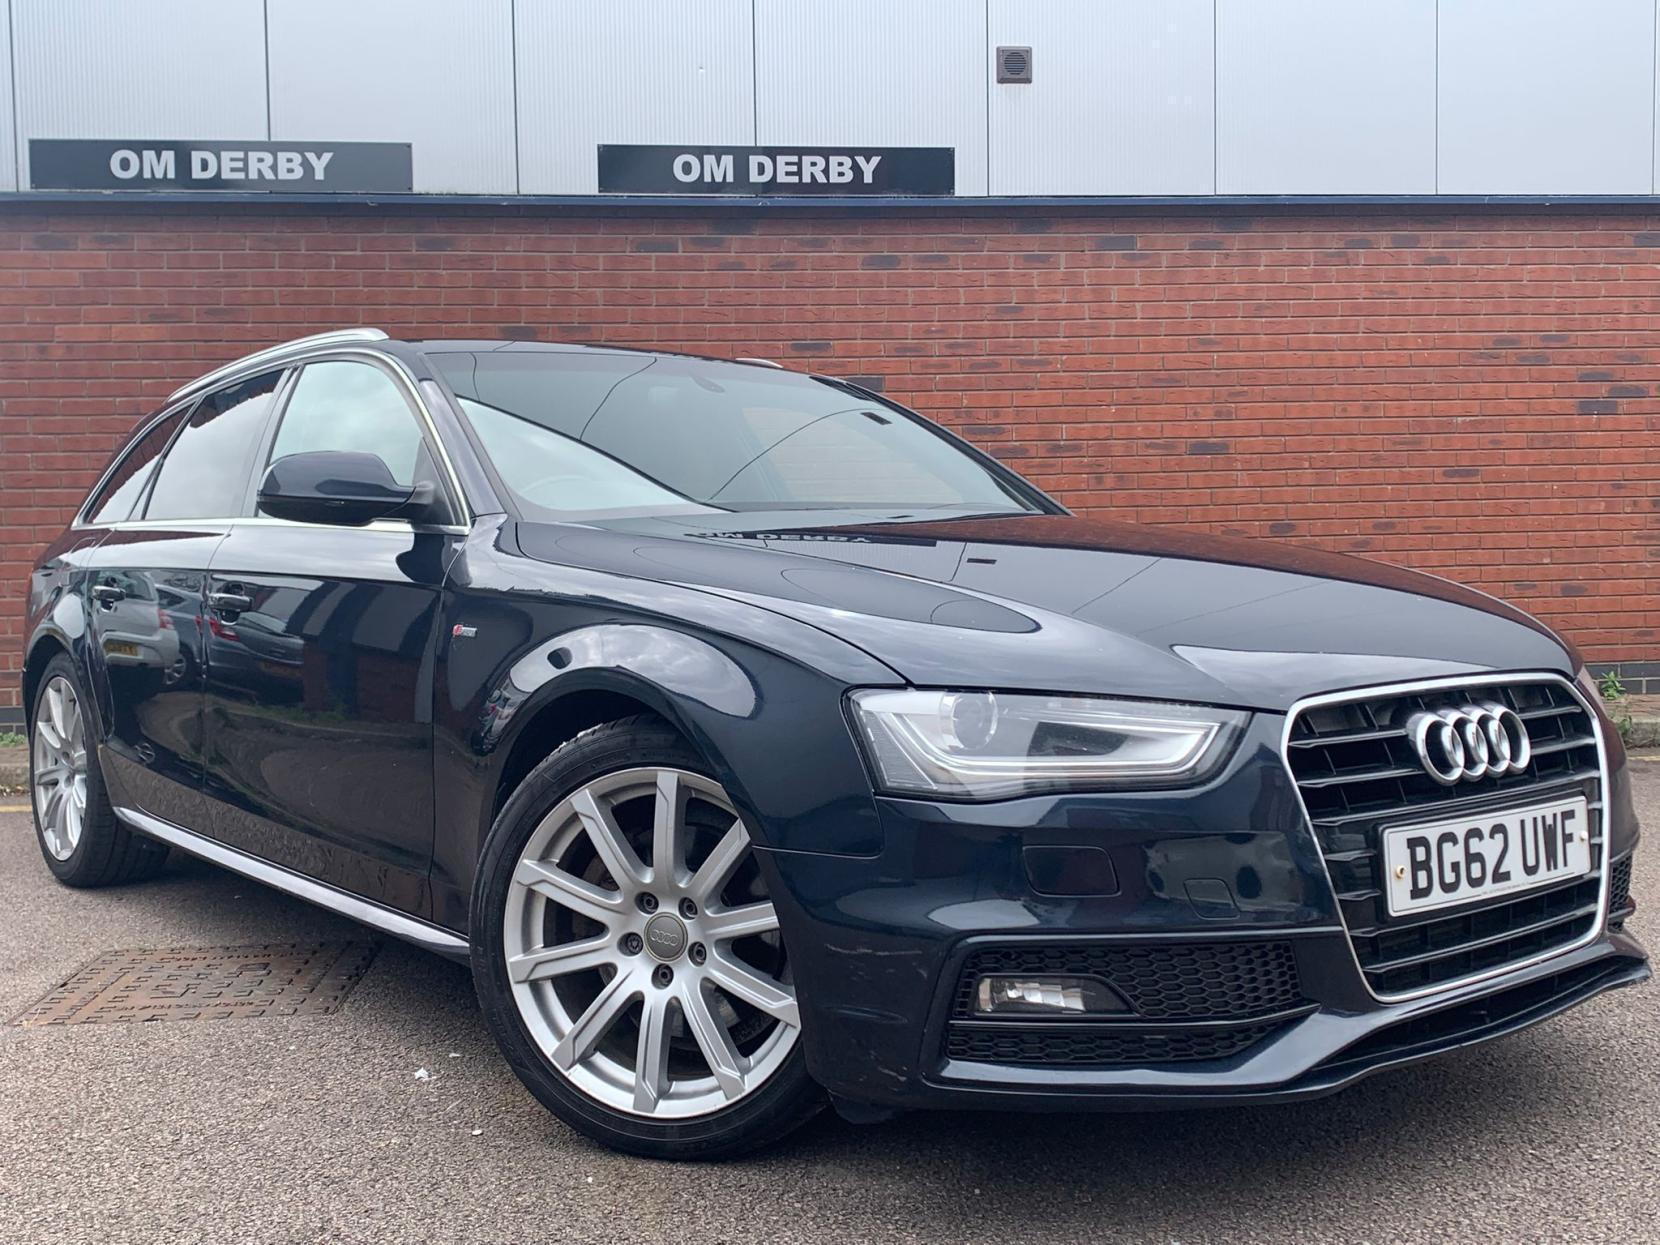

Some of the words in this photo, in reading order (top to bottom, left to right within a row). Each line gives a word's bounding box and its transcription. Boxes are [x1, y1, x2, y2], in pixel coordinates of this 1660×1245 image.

[109, 149, 176, 180] OM
[190, 150, 334, 181] DERBY
[672, 154, 735, 183] OM
[748, 155, 882, 184] DERBY
[1406, 823, 1511, 900] BG62
[1520, 809, 1576, 876] UWF
